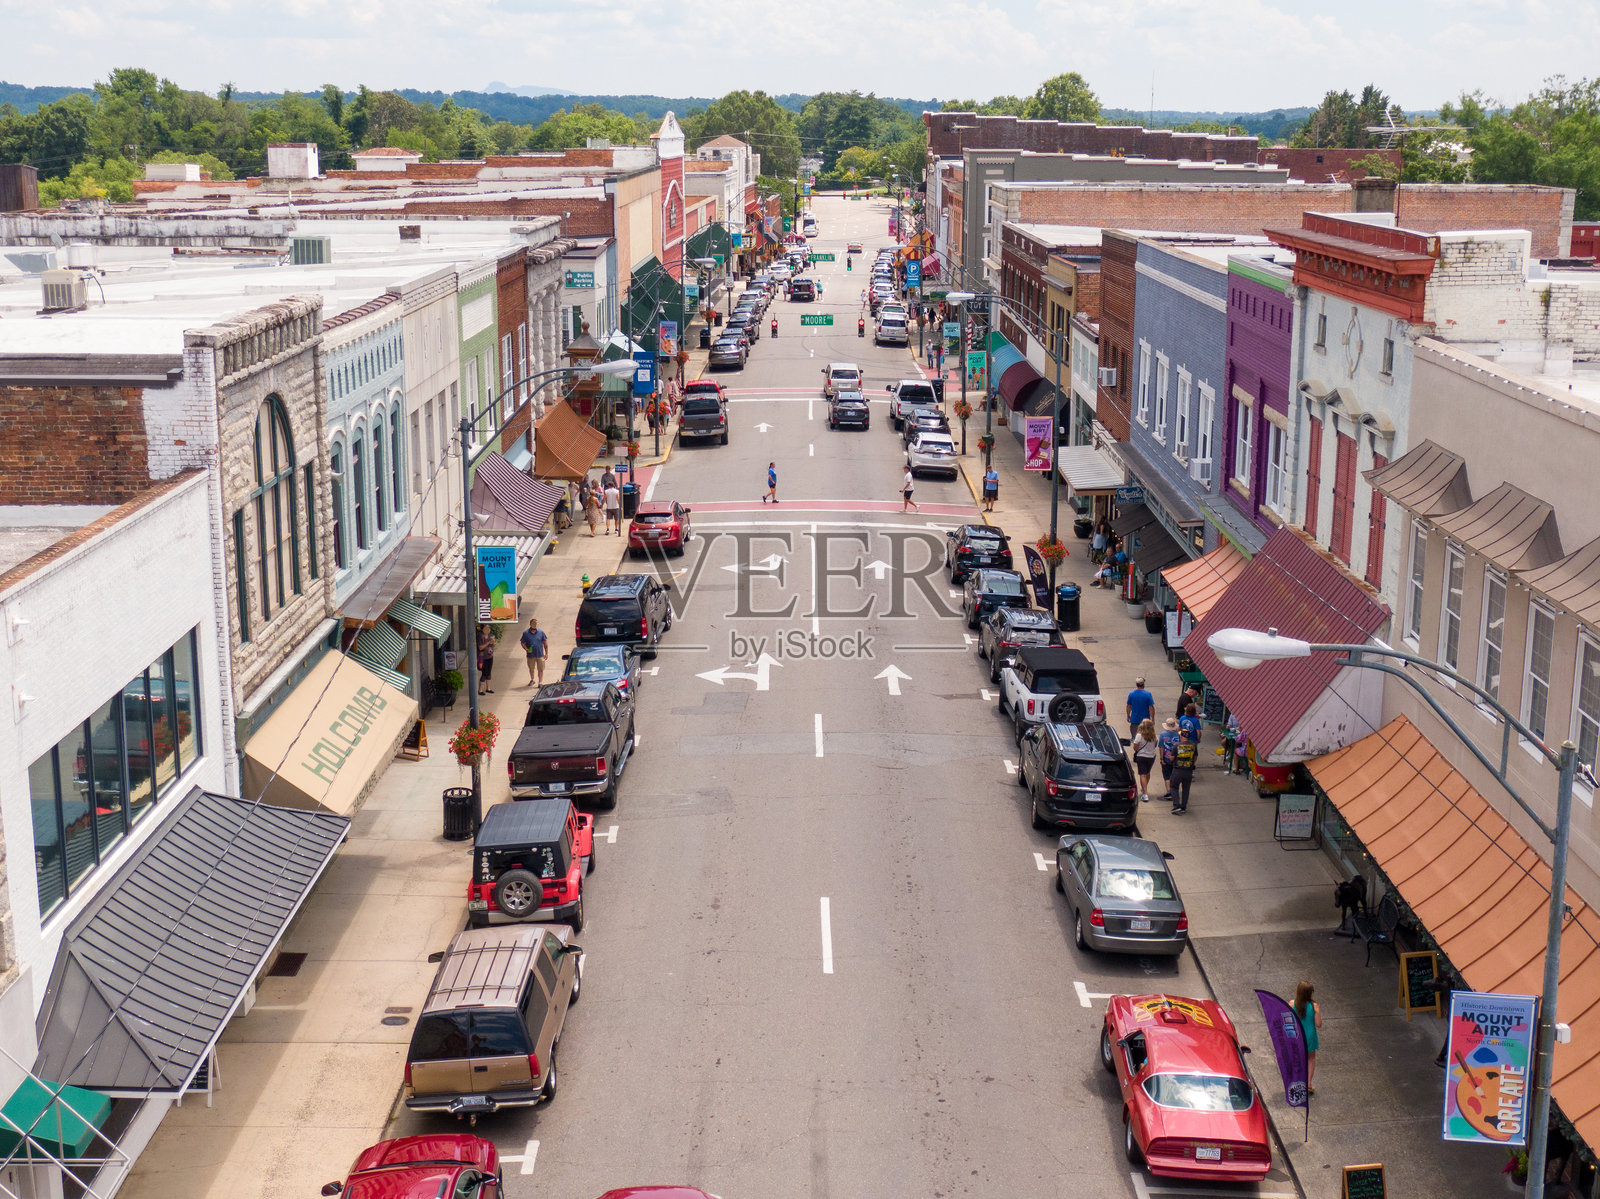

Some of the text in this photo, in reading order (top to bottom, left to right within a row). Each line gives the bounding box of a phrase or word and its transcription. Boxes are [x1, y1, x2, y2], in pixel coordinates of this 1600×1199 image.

[910, 264, 917, 273] P
[805, 316, 826, 324] MOORE
[480, 598, 491, 619] DINE
[301, 686, 388, 784] HOLCOMB
[1461, 1002, 1525, 1013] Historic Downtown
[1461, 1011, 1524, 1027] MOUNT
[1471, 1024, 1512, 1038] AIRY
[1466, 1038, 1515, 1048] North Carolina
[1496, 1063, 1525, 1135] CREATE
